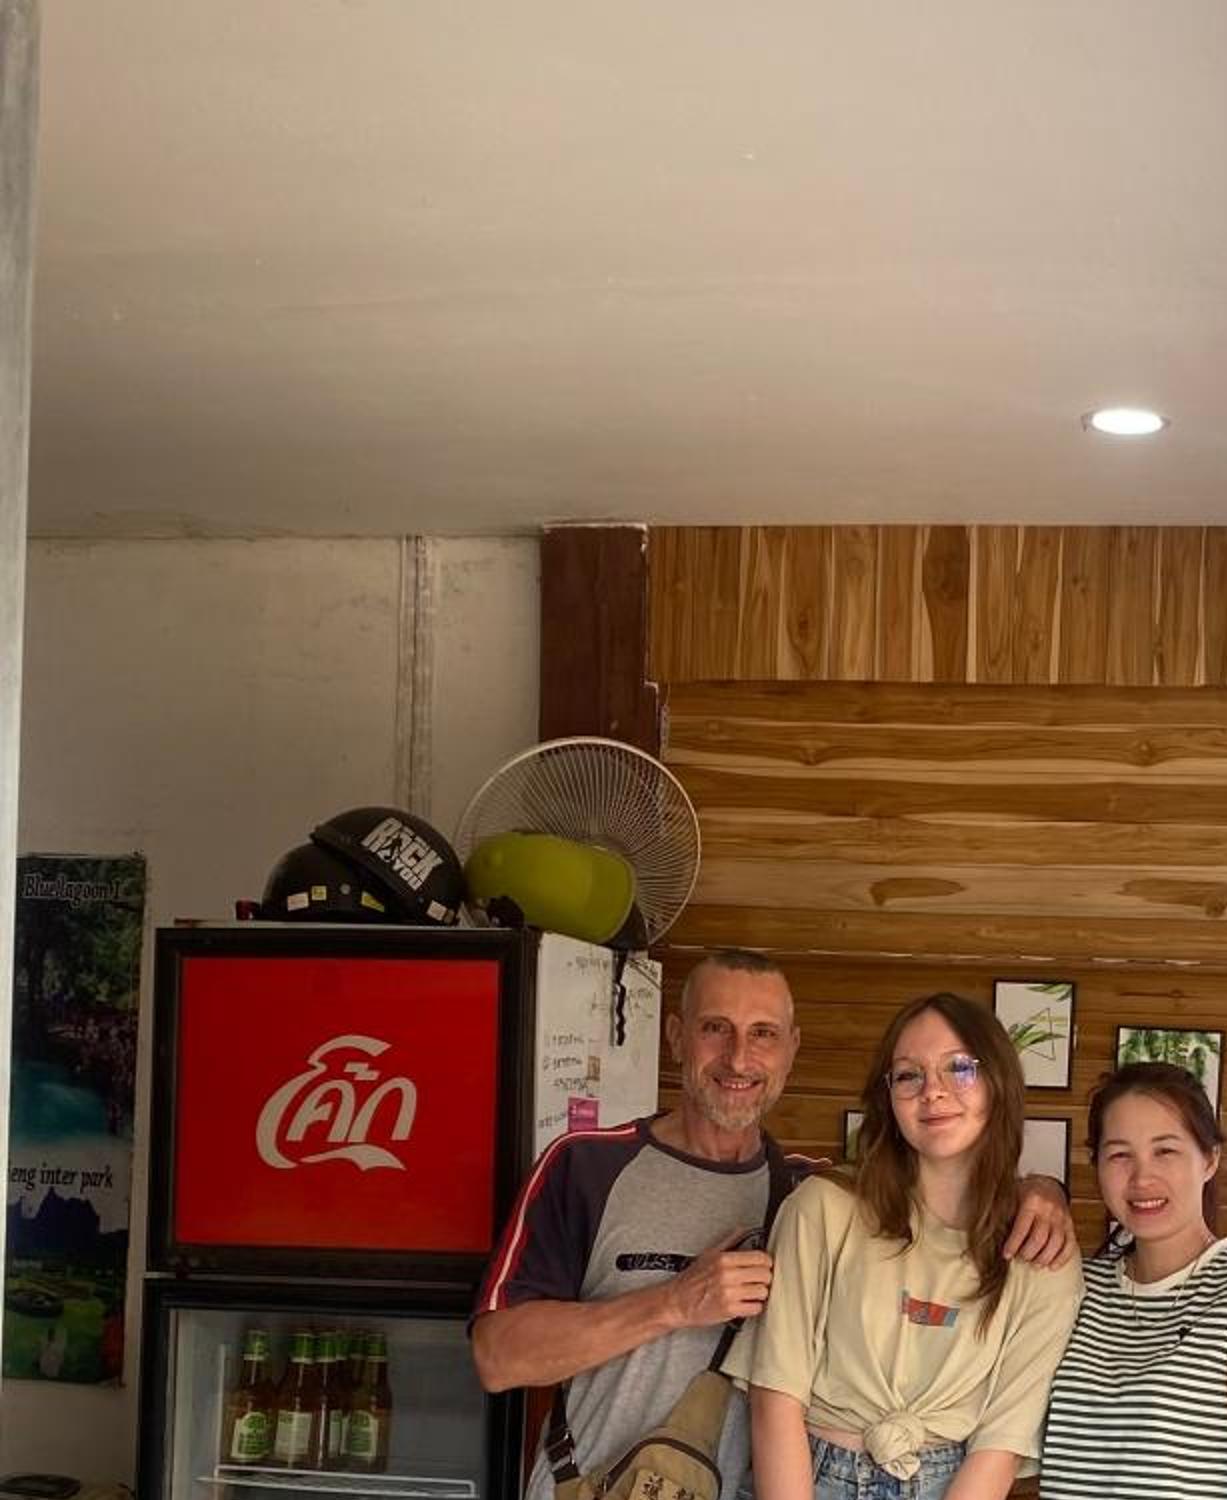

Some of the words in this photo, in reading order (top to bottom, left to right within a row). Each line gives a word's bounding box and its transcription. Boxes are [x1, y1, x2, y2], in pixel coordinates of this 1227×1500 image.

[361, 817, 443, 882] ROCK
[40, 1162, 78, 1185] inter
[80, 1164, 113, 1194] park
